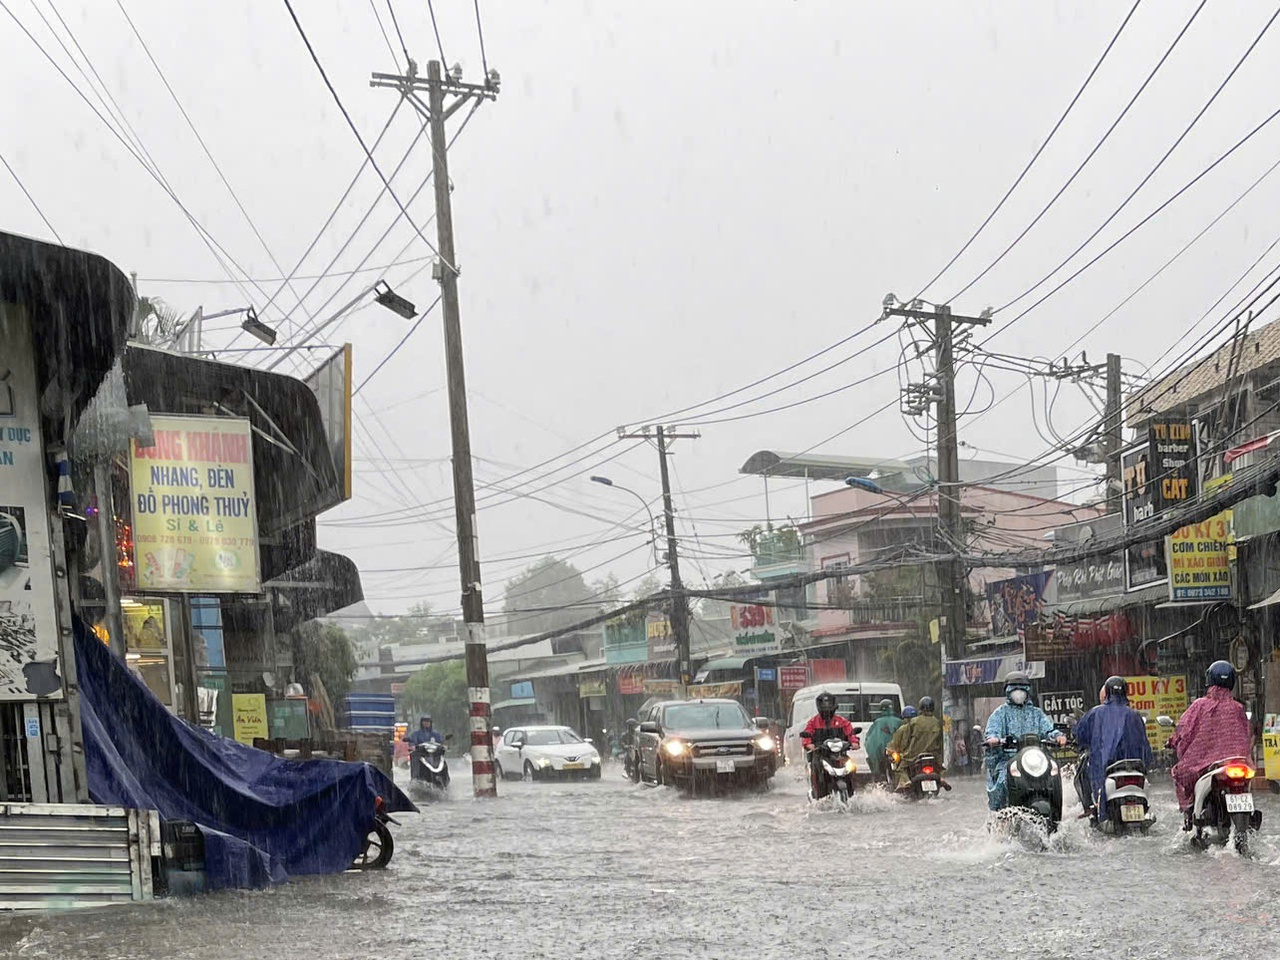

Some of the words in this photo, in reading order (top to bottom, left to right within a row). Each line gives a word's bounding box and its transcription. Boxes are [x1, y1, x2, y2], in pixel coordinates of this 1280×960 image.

[1157, 443, 1189, 453] barber
[1162, 458, 1186, 468] Shop
[150, 465, 203, 491] NHANG,
[161, 494, 210, 516] PHONG
[187, 519, 199, 532] &
[1216, 520, 1226, 538] 3
[1126, 680, 1147, 696] DU
[1174, 678, 1185, 694] 3
[1064, 694, 1085, 710] TÓC
[1264, 737, 1279, 748] TRÀ
